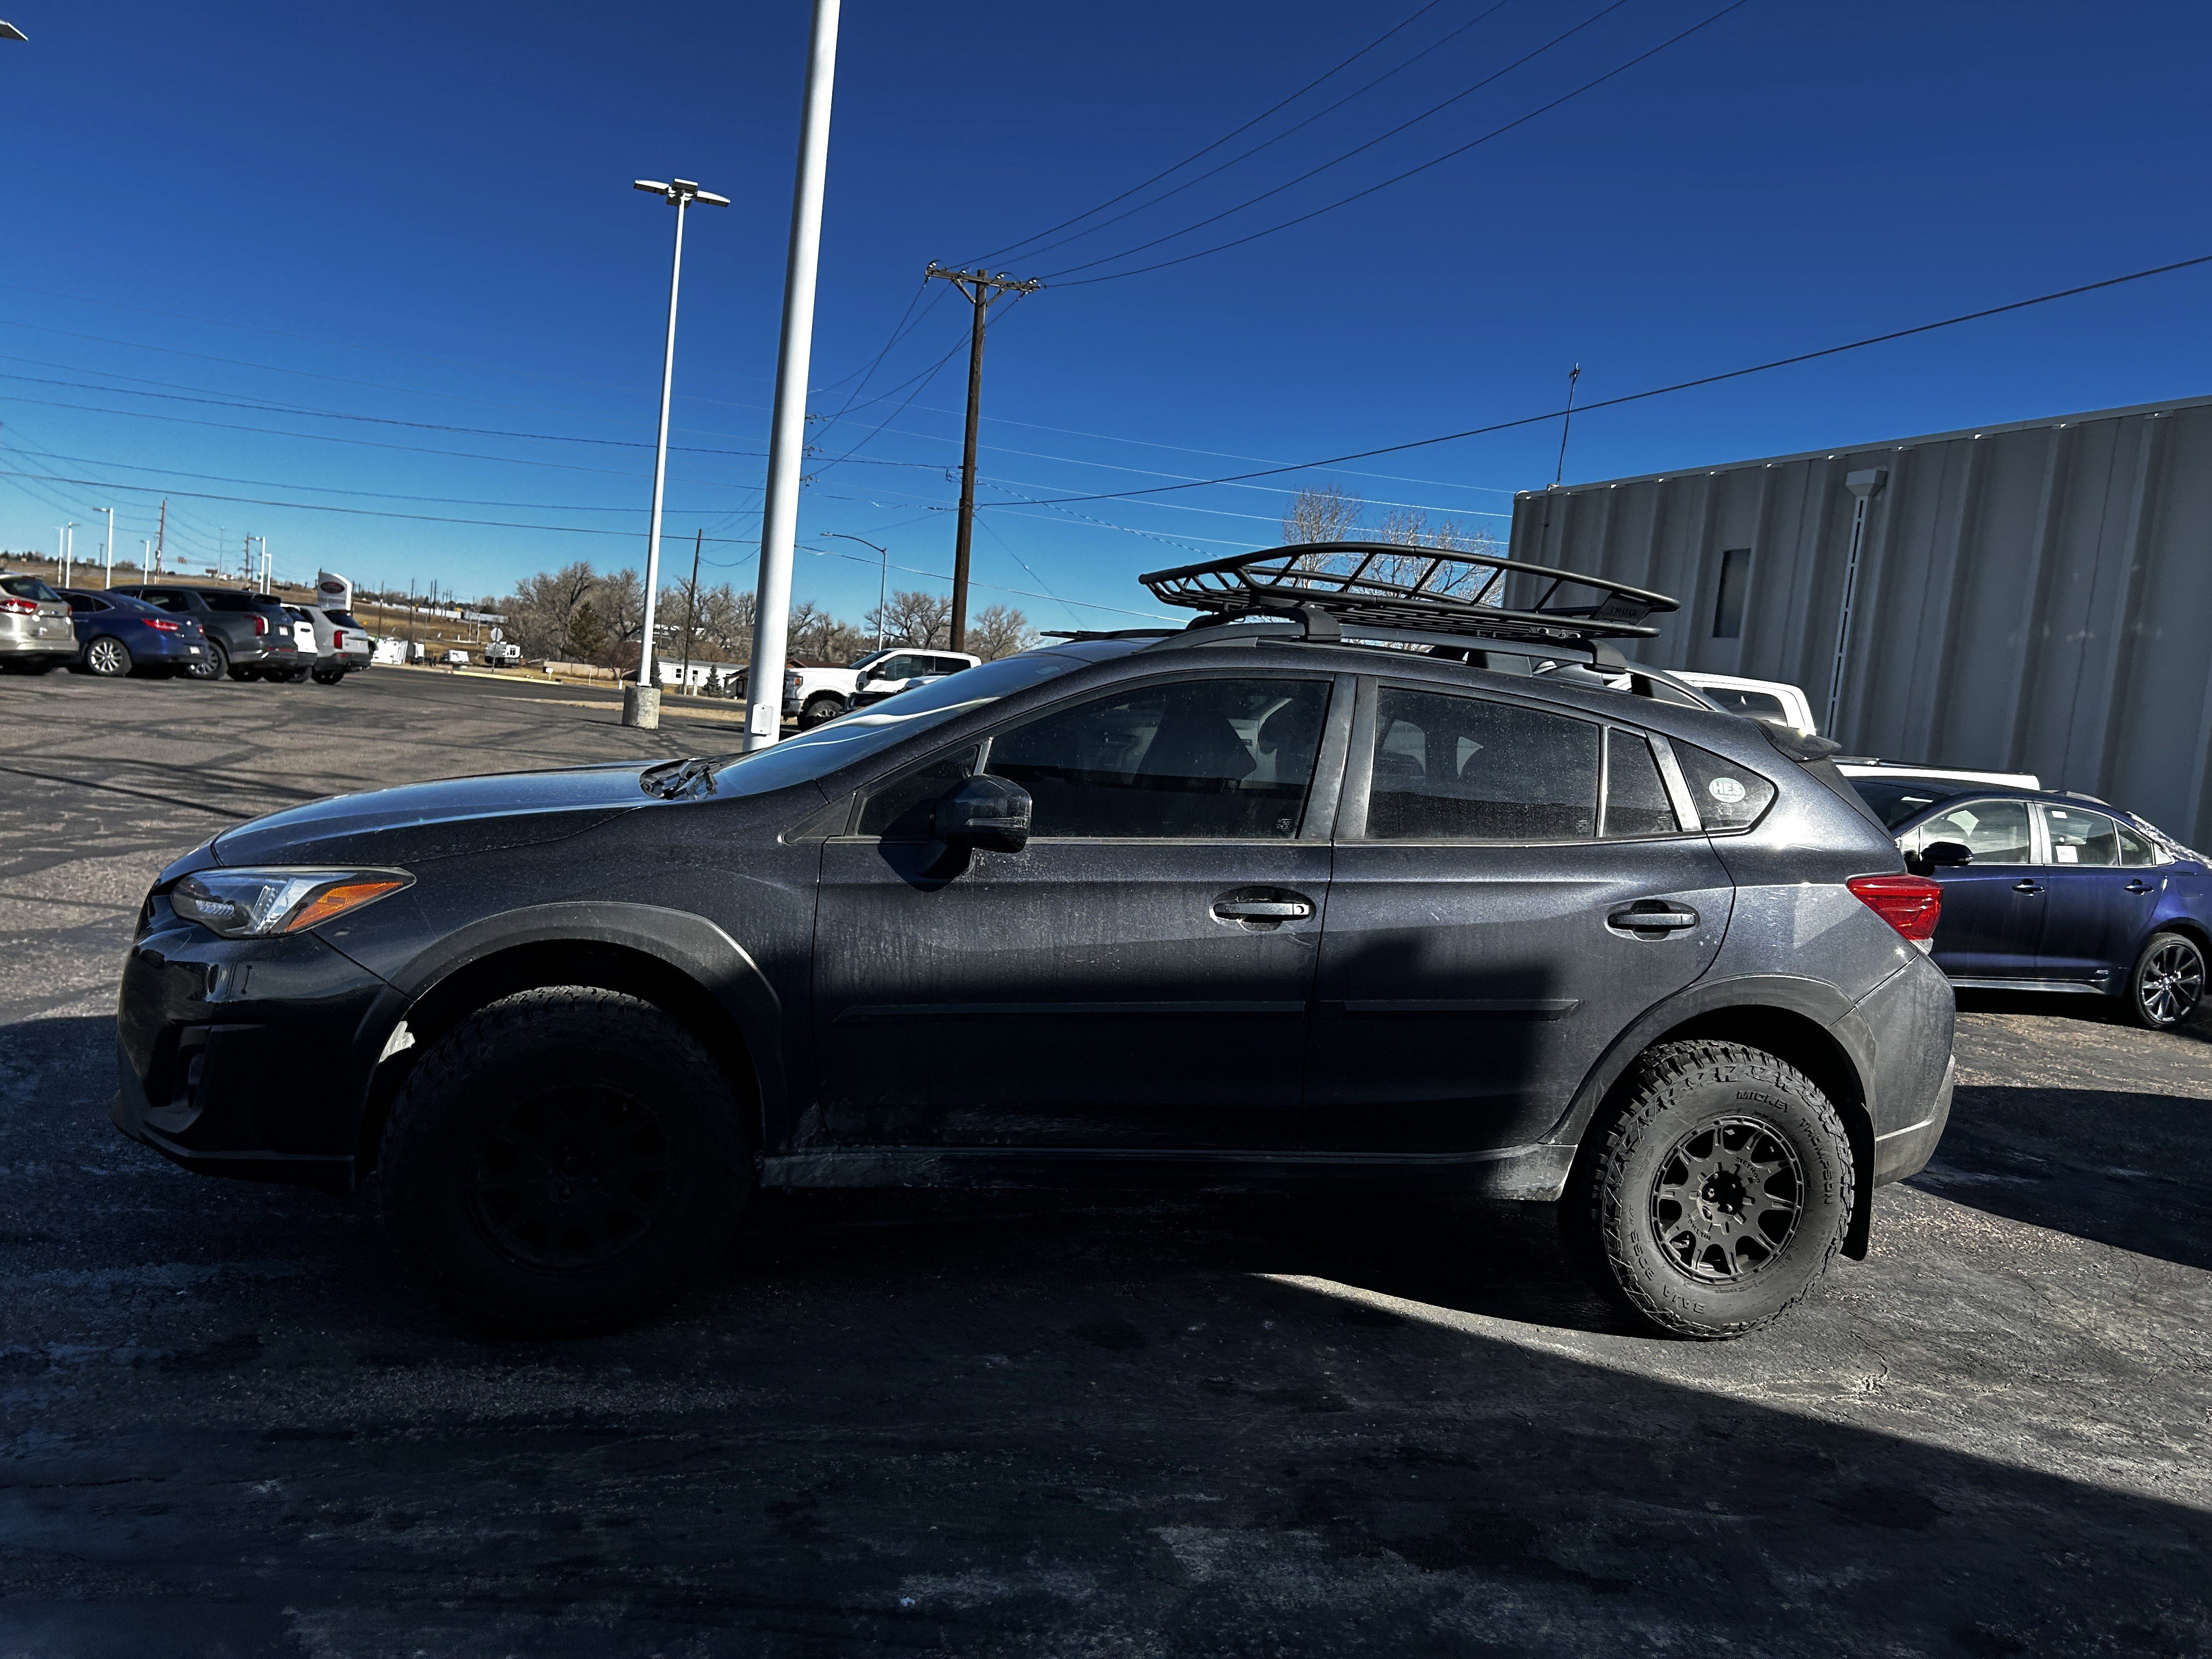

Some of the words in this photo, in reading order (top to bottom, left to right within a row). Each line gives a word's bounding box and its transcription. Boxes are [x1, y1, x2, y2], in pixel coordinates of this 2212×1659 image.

[1712, 782, 1742, 796] HES
[1736, 1091, 1792, 1113] MICKEY
[1799, 1117, 1834, 1205] THOMPSON
[1734, 1156, 1760, 1184] METHOD
[1630, 1230, 1655, 1281] BOSS
[1662, 1284, 1707, 1314] BAJA
